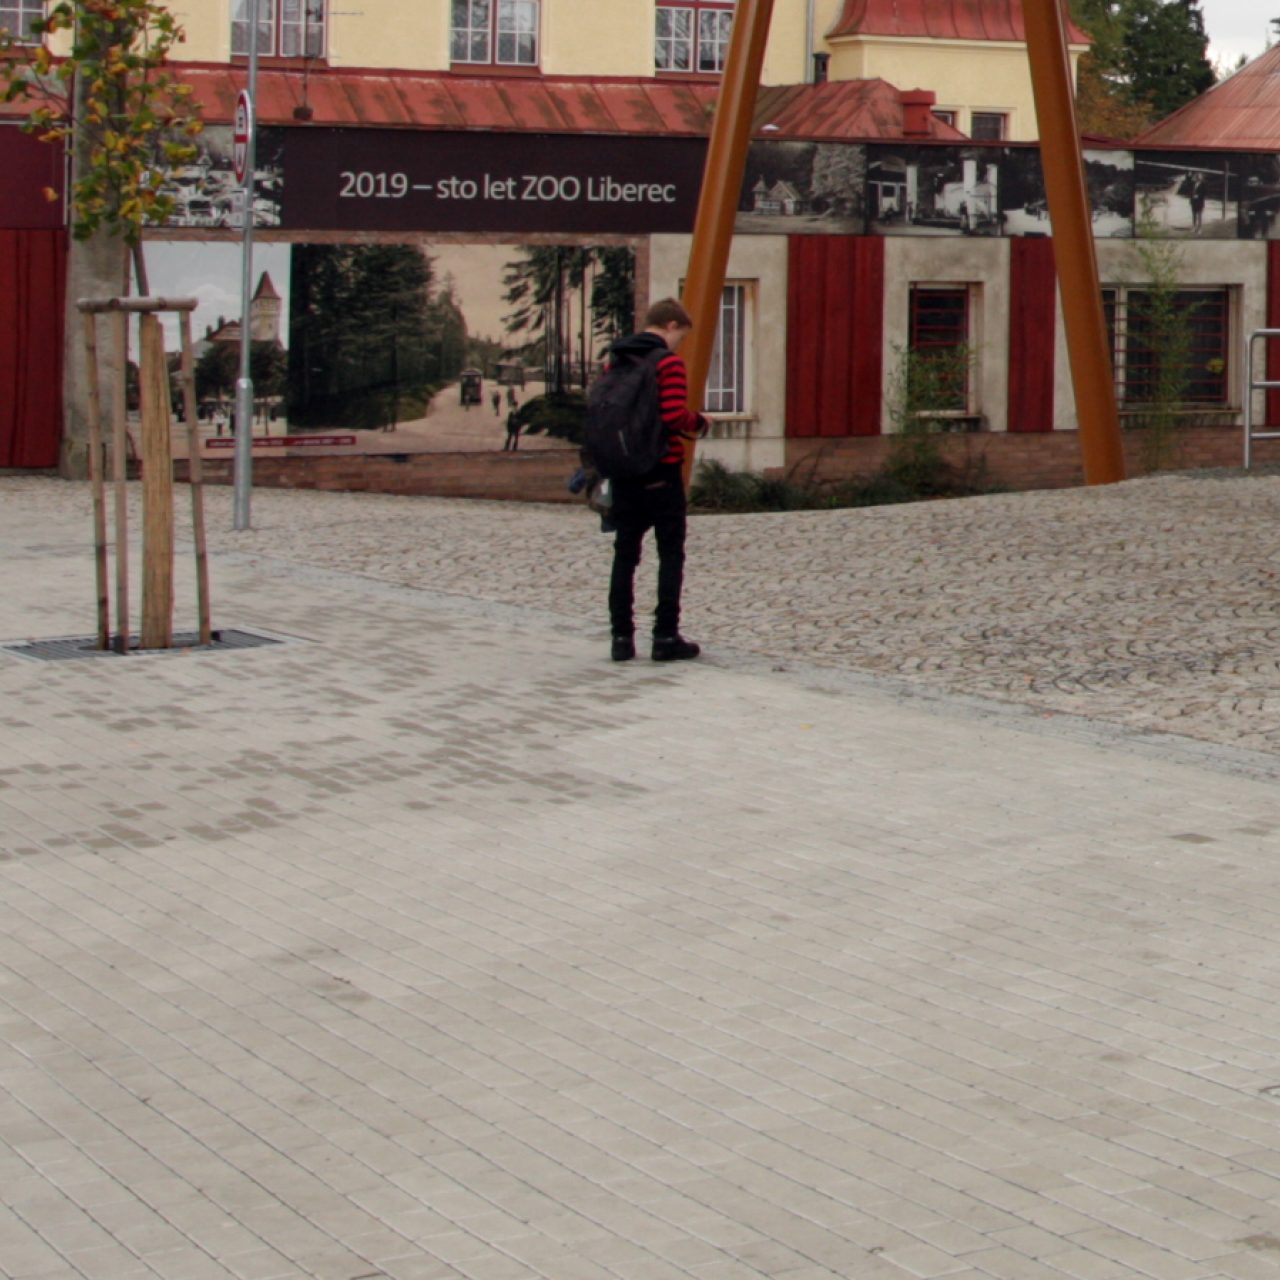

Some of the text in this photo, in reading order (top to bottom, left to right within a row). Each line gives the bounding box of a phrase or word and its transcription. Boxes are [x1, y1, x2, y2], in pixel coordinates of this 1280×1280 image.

[339, 171, 408, 198] 2019
[436, 175, 478, 200] sto
[483, 173, 517, 200] let
[520, 175, 581, 202] ZOO
[587, 175, 676, 203] Liberec
